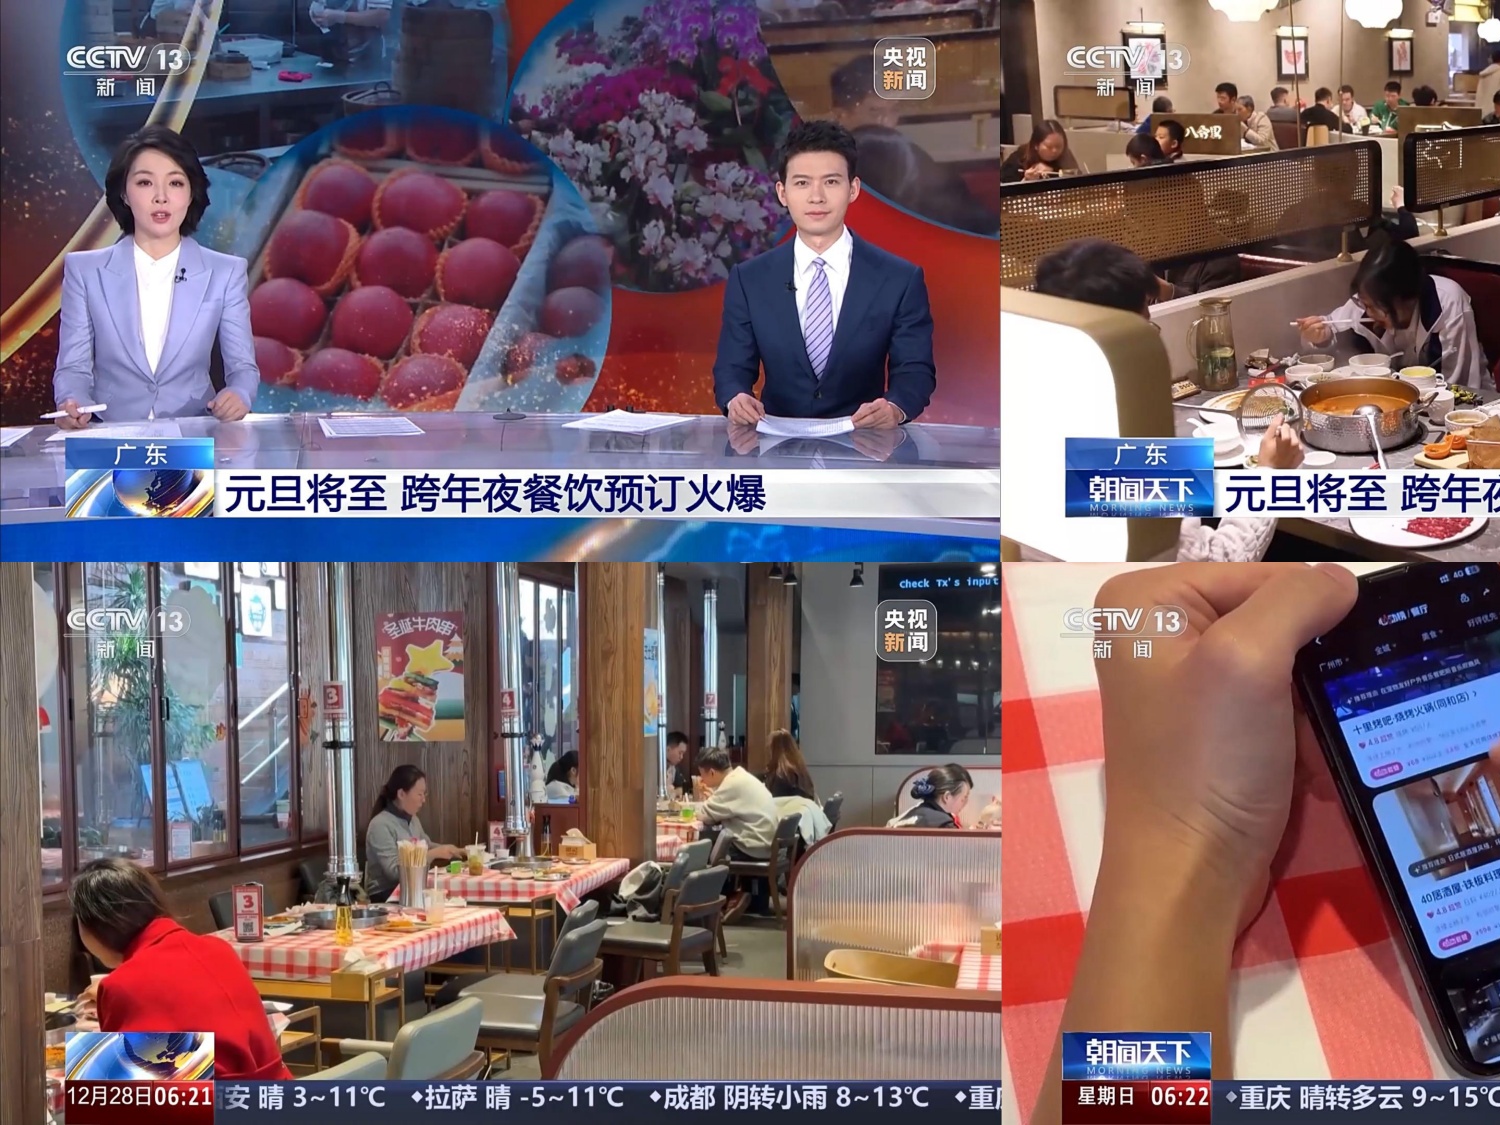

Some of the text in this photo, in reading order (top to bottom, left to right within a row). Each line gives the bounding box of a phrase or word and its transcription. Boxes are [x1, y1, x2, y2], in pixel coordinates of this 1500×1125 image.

[1453, 570, 1464, 579] 4G
[967, 577, 999, 587] input
[384, 616, 455, 640] 圣诞牛肉串
[1319, 612, 1498, 672] 广州市 全城 美食 好评优先
[326, 687, 338, 704] 3
[503, 692, 511, 704] 4
[243, 895, 254, 908] 3
